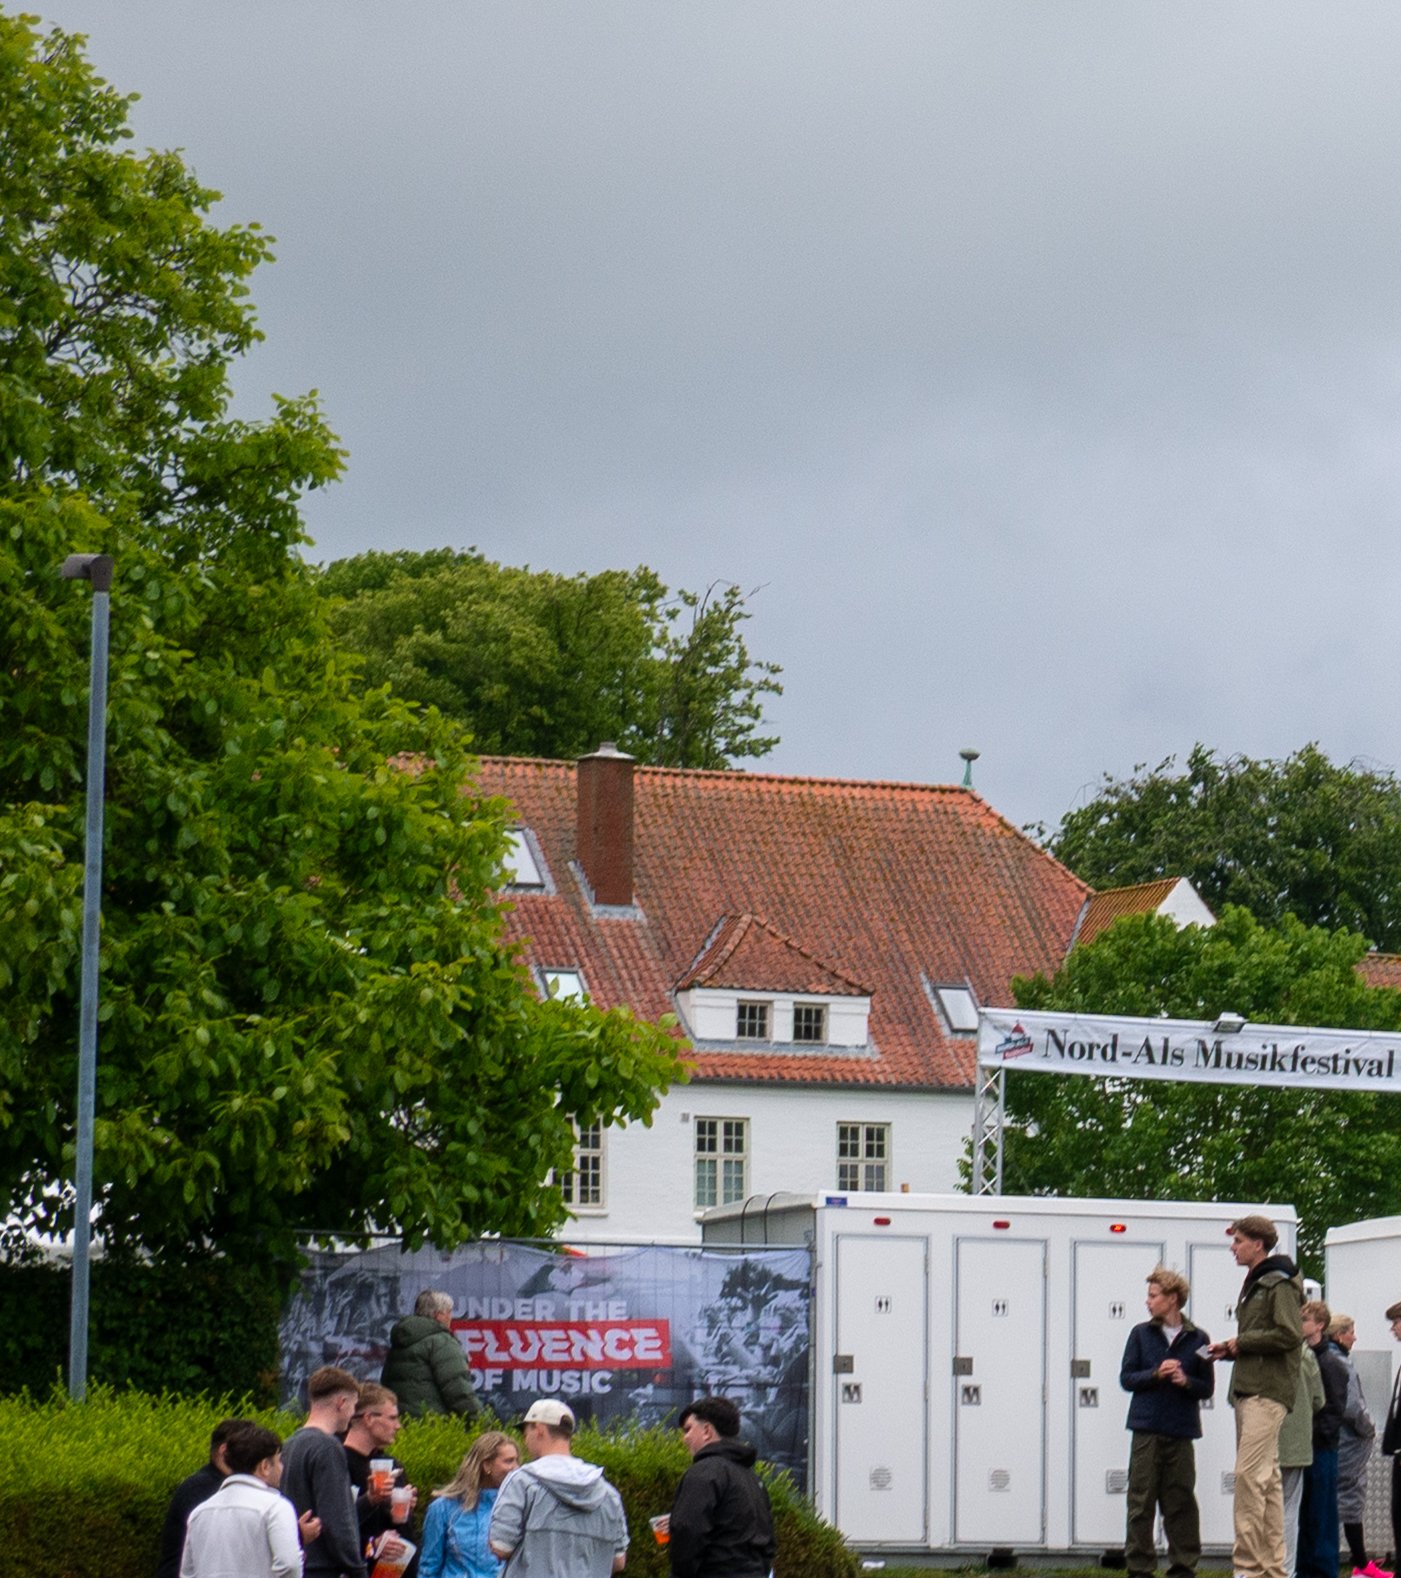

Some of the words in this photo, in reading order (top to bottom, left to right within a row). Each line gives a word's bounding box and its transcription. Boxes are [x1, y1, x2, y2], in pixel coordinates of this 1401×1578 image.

[1042, 1028, 1185, 1067] Nord-Als
[1194, 1038, 1395, 1078] Musikfestival
[452, 1296, 556, 1321] UNDER
[565, 1299, 628, 1322] THE
[454, 1328, 663, 1362] FLUENCE
[512, 1369, 613, 1394] MUSIC
